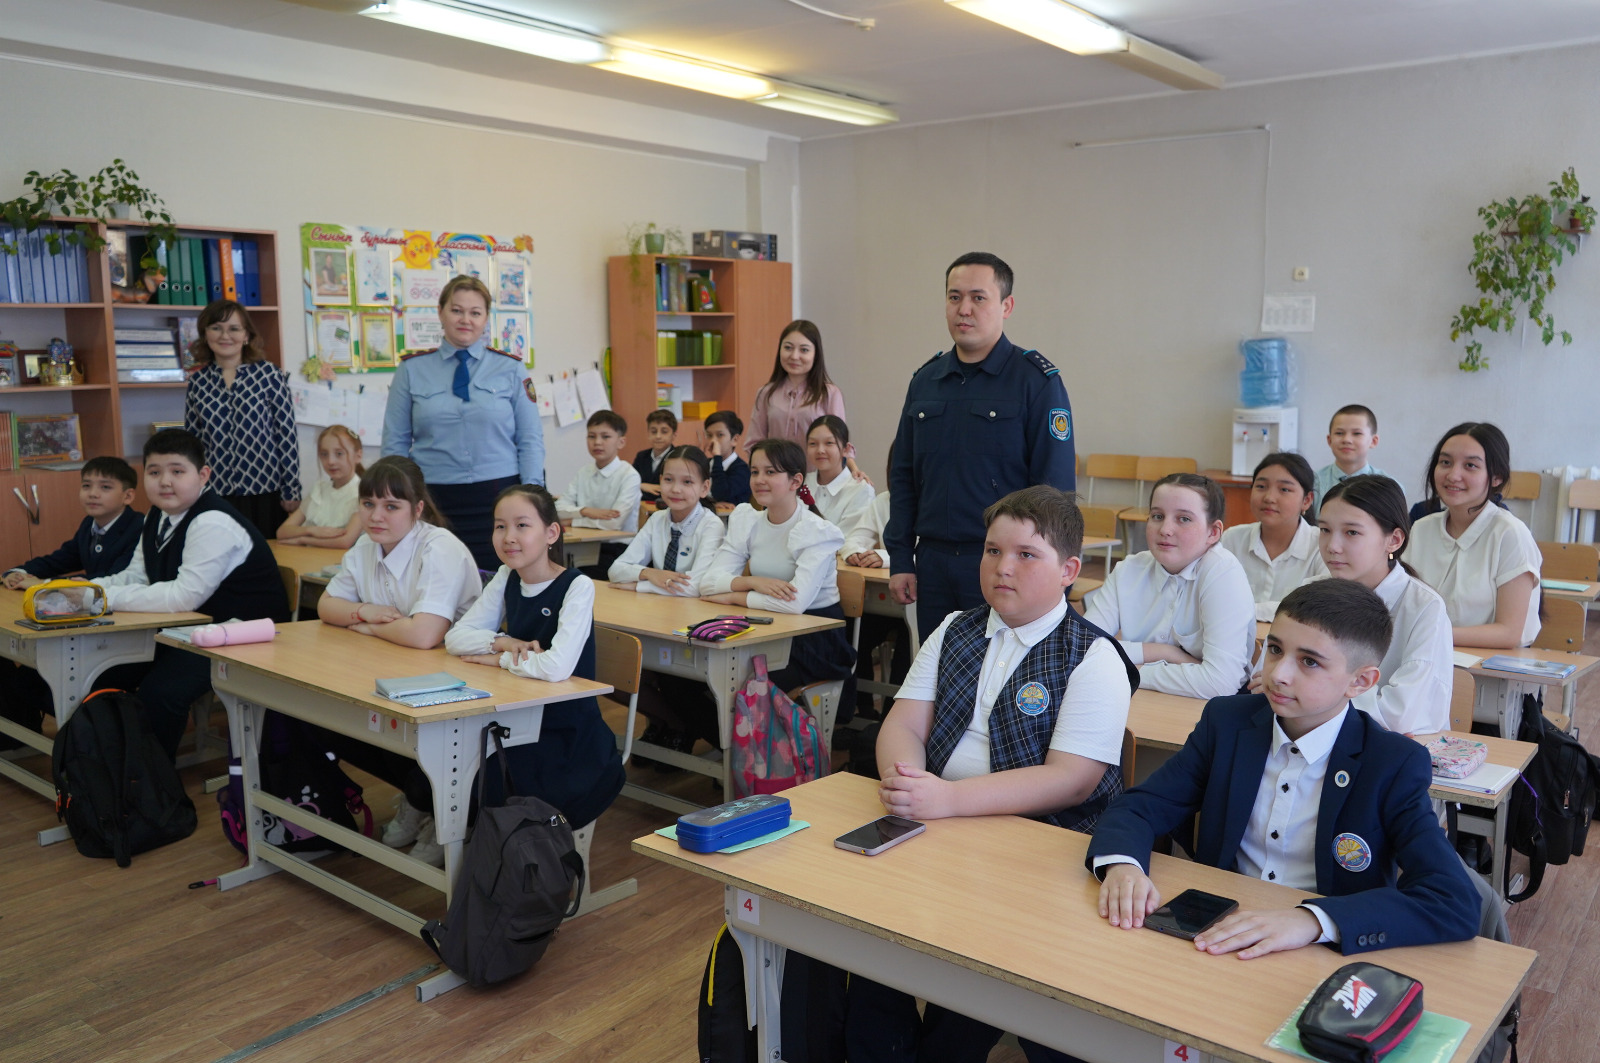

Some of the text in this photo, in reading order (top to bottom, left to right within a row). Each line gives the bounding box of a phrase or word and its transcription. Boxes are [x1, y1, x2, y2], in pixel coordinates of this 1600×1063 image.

[371, 714, 377, 725] 4
[743, 898, 753, 913] 4
[1331, 974, 1378, 1019] NIKE
[1173, 1044, 1189, 1062] 4
